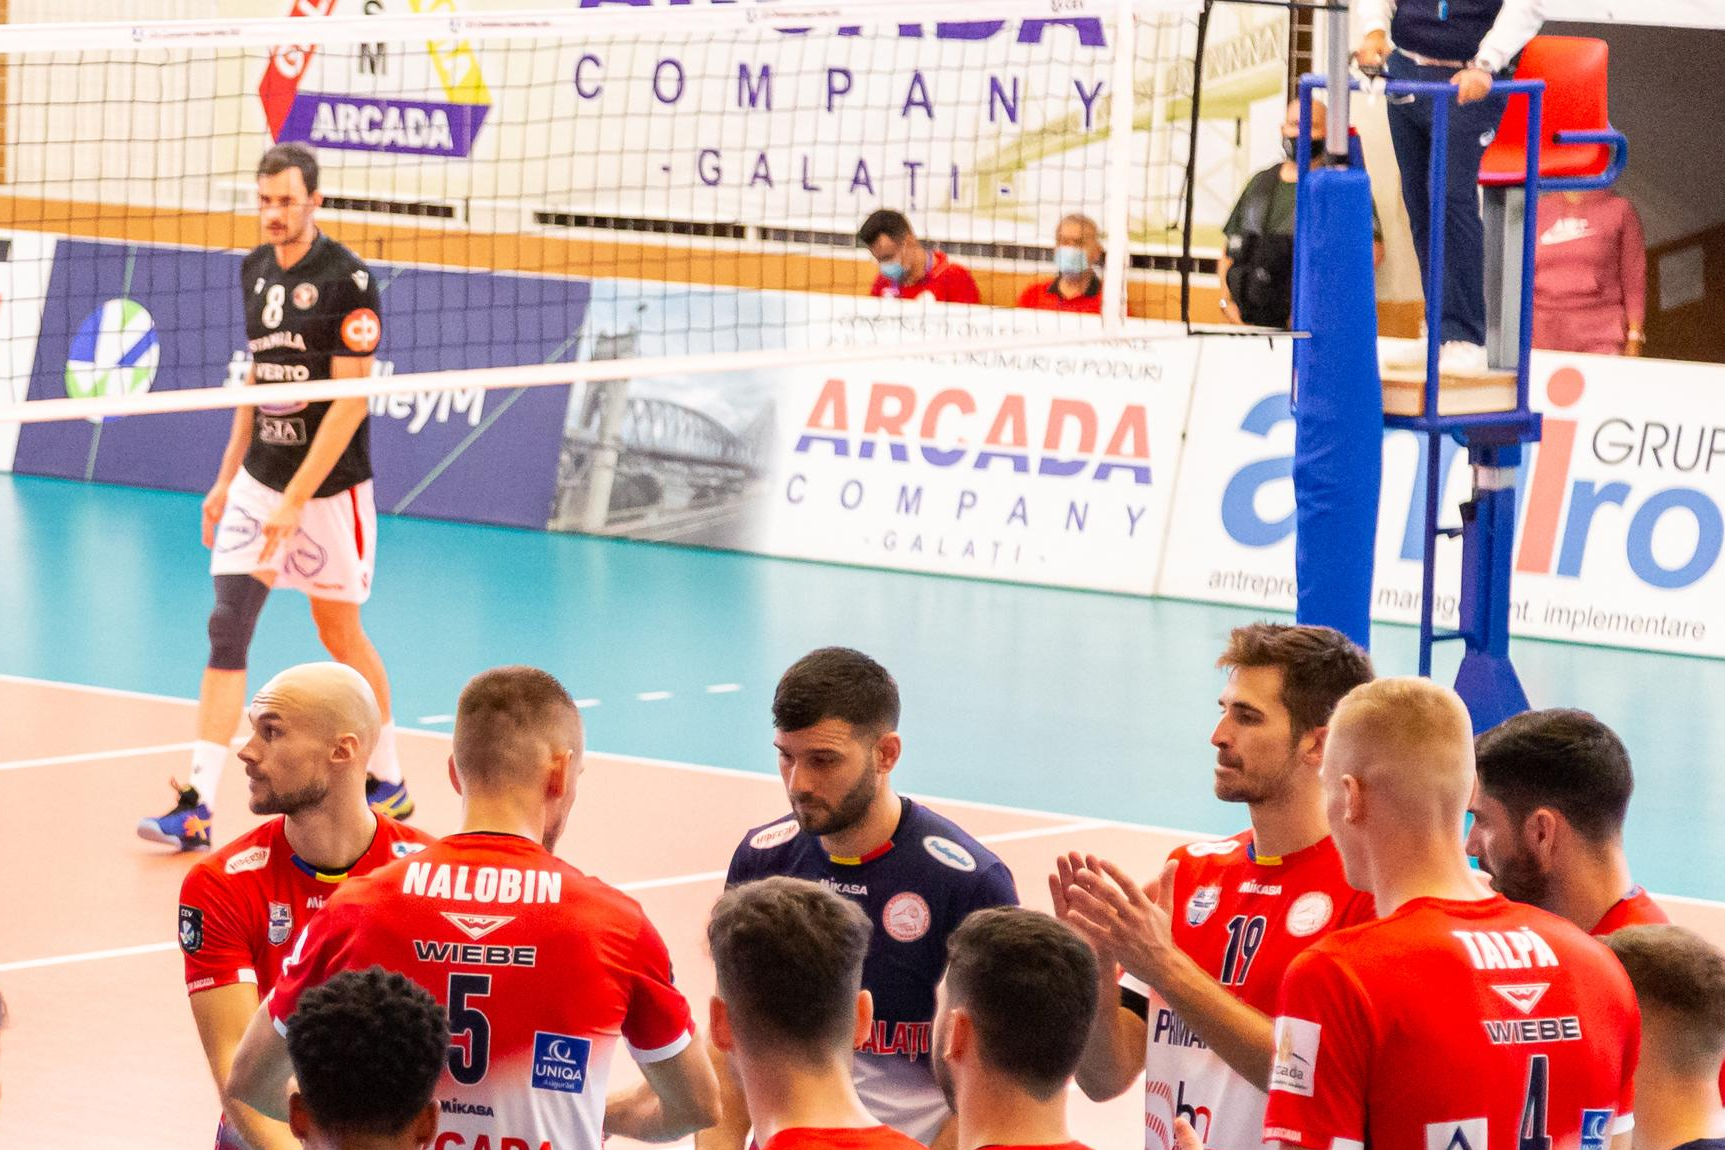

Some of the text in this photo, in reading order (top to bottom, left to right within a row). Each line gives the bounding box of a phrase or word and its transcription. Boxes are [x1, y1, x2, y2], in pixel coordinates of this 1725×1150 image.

[575, 54, 1104, 130] COMPANY
[309, 102, 454, 150] ARCADA
[261, 284, 286, 329] 8
[794, 377, 1154, 485] ARCADA
[785, 474, 1147, 538] COMPANY
[1543, 601, 1706, 642] implementare
[402, 861, 562, 904] NALOBIN
[413, 938, 538, 967] WIEBE
[1220, 914, 1267, 986] 19
[447, 972, 493, 1086] 5
[1482, 1015, 1583, 1045] WIEBE
[536, 1063, 583, 1081] UNIQA
